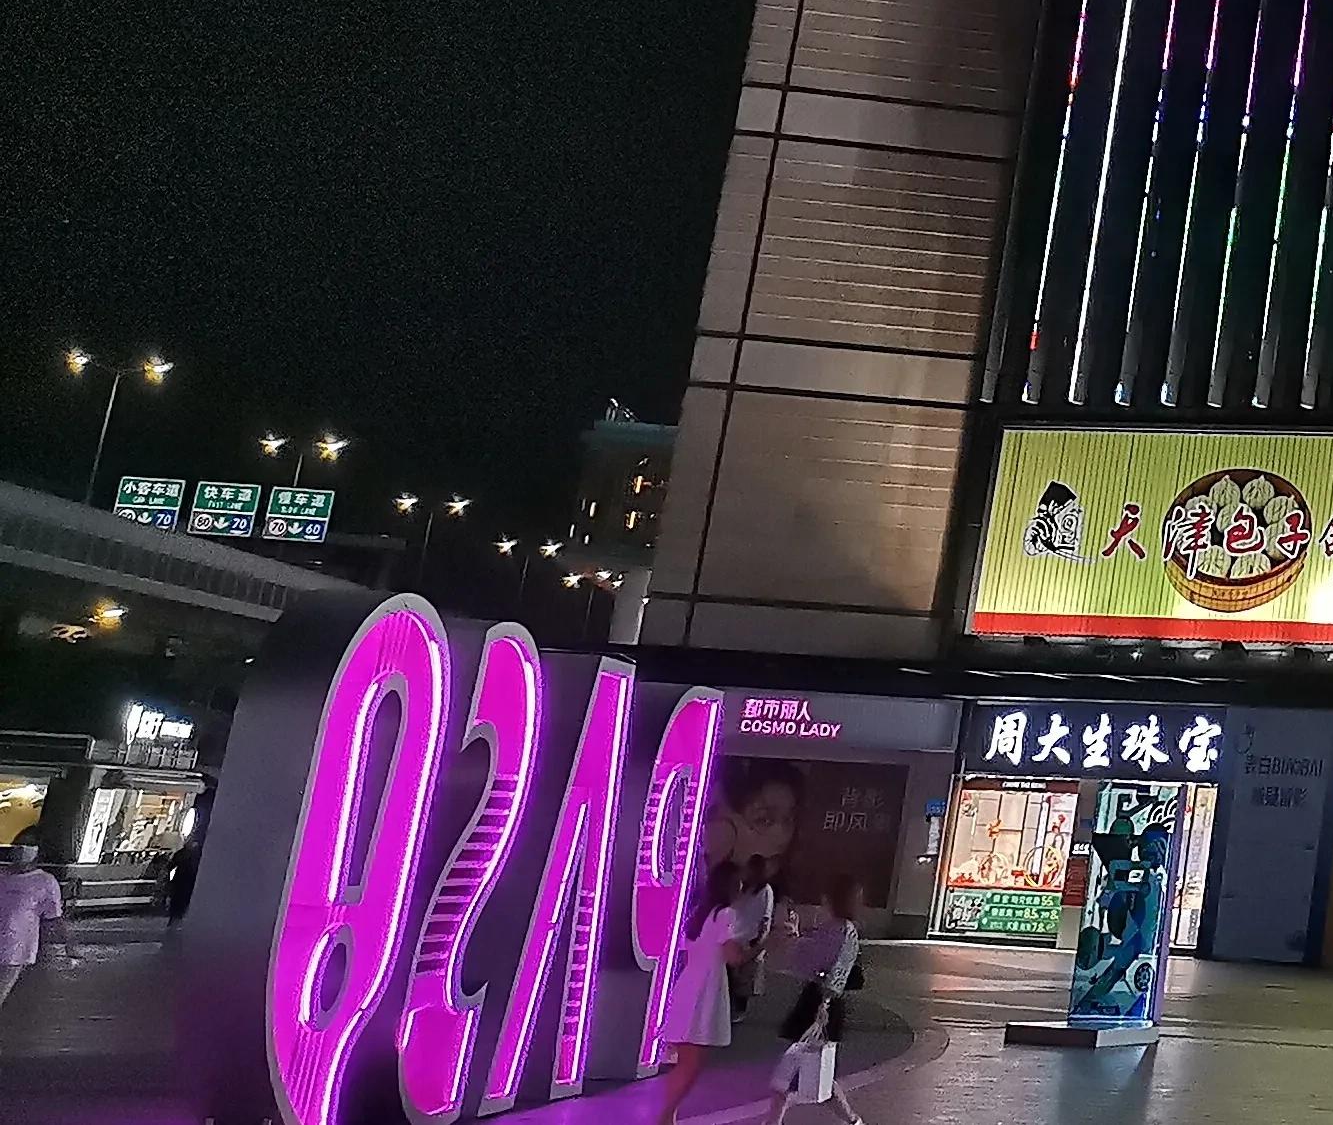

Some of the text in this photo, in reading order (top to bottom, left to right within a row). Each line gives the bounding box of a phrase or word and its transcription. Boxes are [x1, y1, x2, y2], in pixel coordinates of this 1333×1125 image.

[204, 485, 252, 502] 快车道
[155, 512, 172, 526] 70
[231, 516, 248, 530] 70
[271, 520, 321, 535] 70 60
[744, 698, 812, 722] 都市丽人
[739, 719, 842, 738] COSMO LADY
[984, 711, 1224, 773] 周大生珠宝
